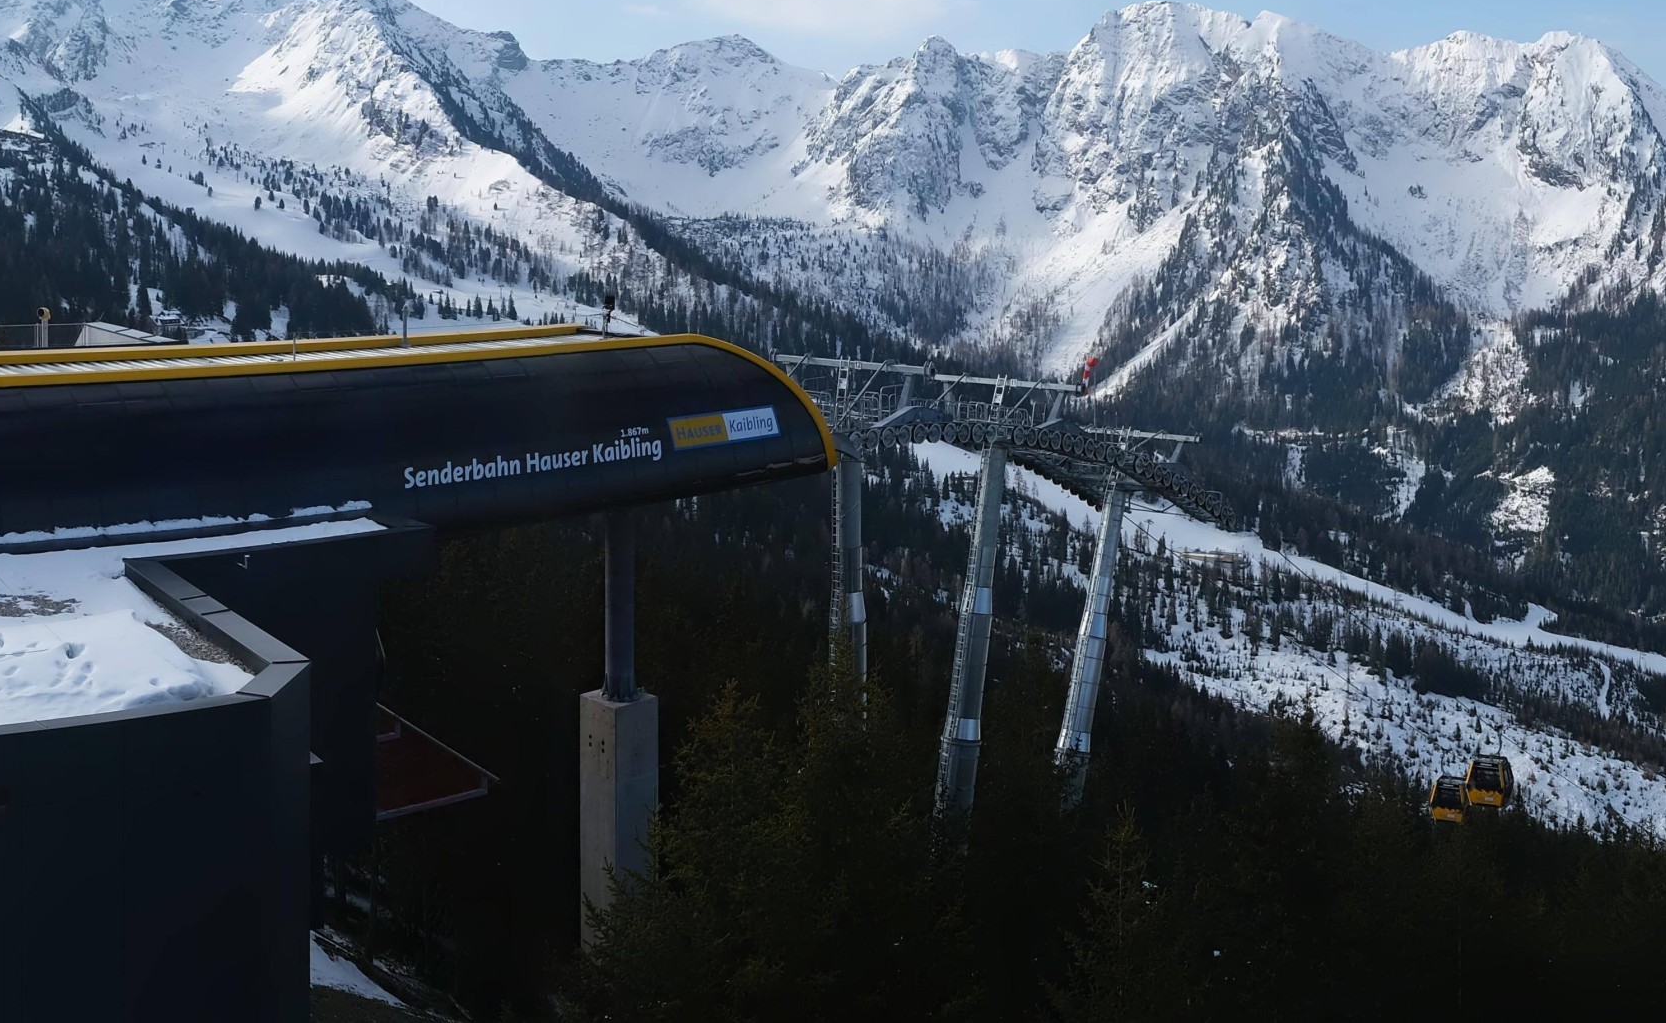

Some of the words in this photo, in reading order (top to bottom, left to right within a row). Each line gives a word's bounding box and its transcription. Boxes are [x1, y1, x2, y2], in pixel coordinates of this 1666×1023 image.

[620, 427, 649, 438] 1.867m
[677, 424, 722, 441] HAUSER
[729, 416, 773, 433] Kaibling
[404, 455, 521, 489] Senderbahn
[526, 449, 588, 473] Hauser
[592, 438, 662, 464] Kaibling
